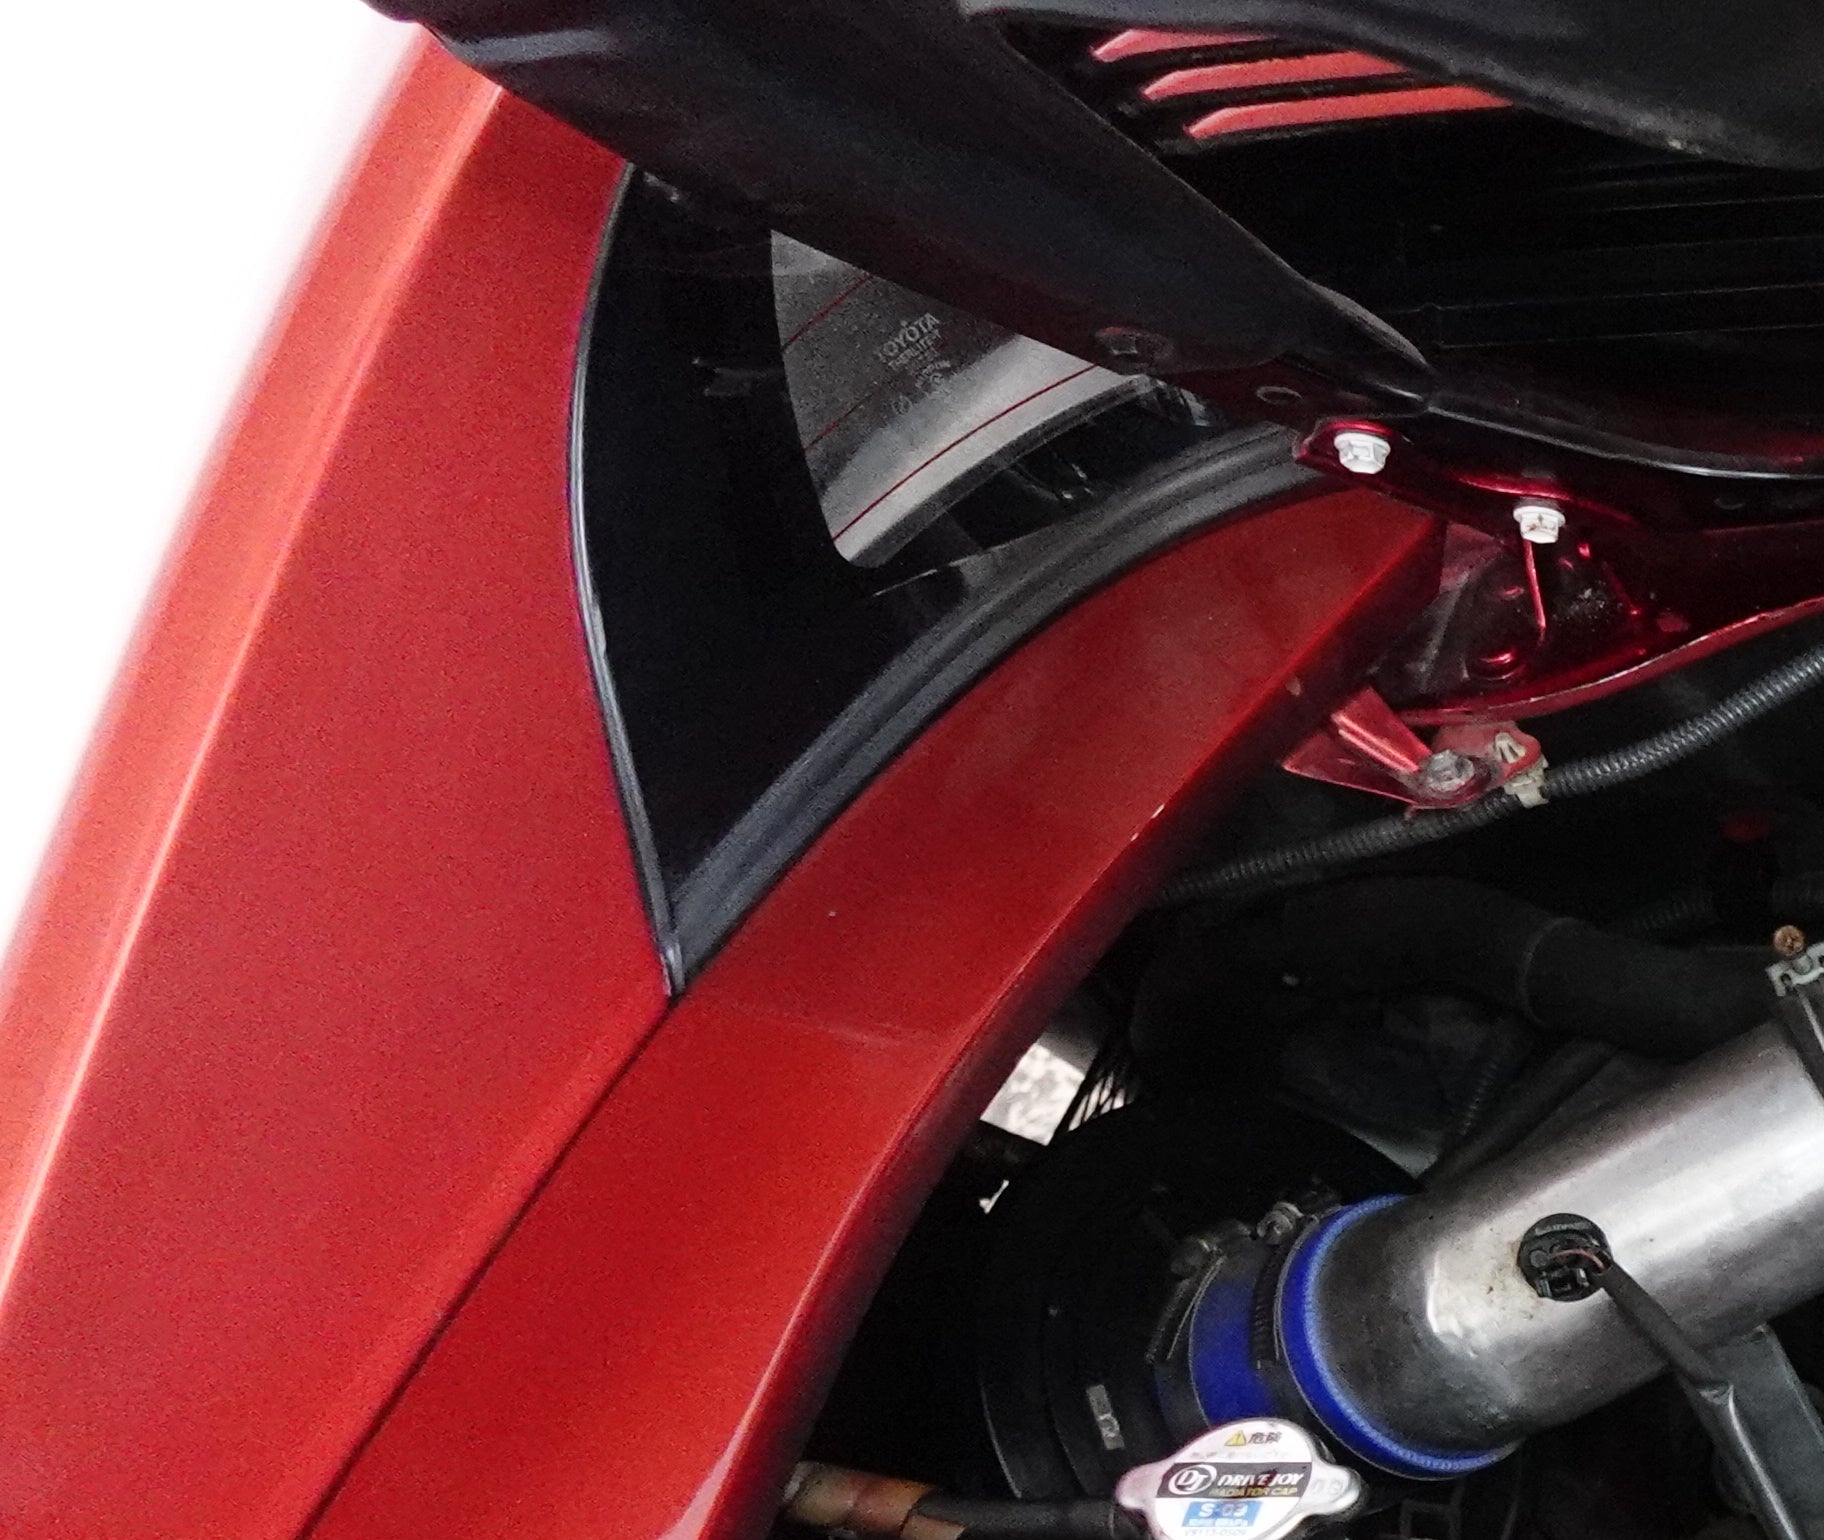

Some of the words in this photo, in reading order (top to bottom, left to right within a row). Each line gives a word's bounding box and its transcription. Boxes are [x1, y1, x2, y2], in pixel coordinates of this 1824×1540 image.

[877, 312, 940, 362] TOYOTA
[1249, 1431, 1282, 1445] 危険
[1217, 1473, 1271, 1487] DRIVE
[1270, 1472, 1304, 1486] JOY
[1272, 1486, 1299, 1498] CAP
